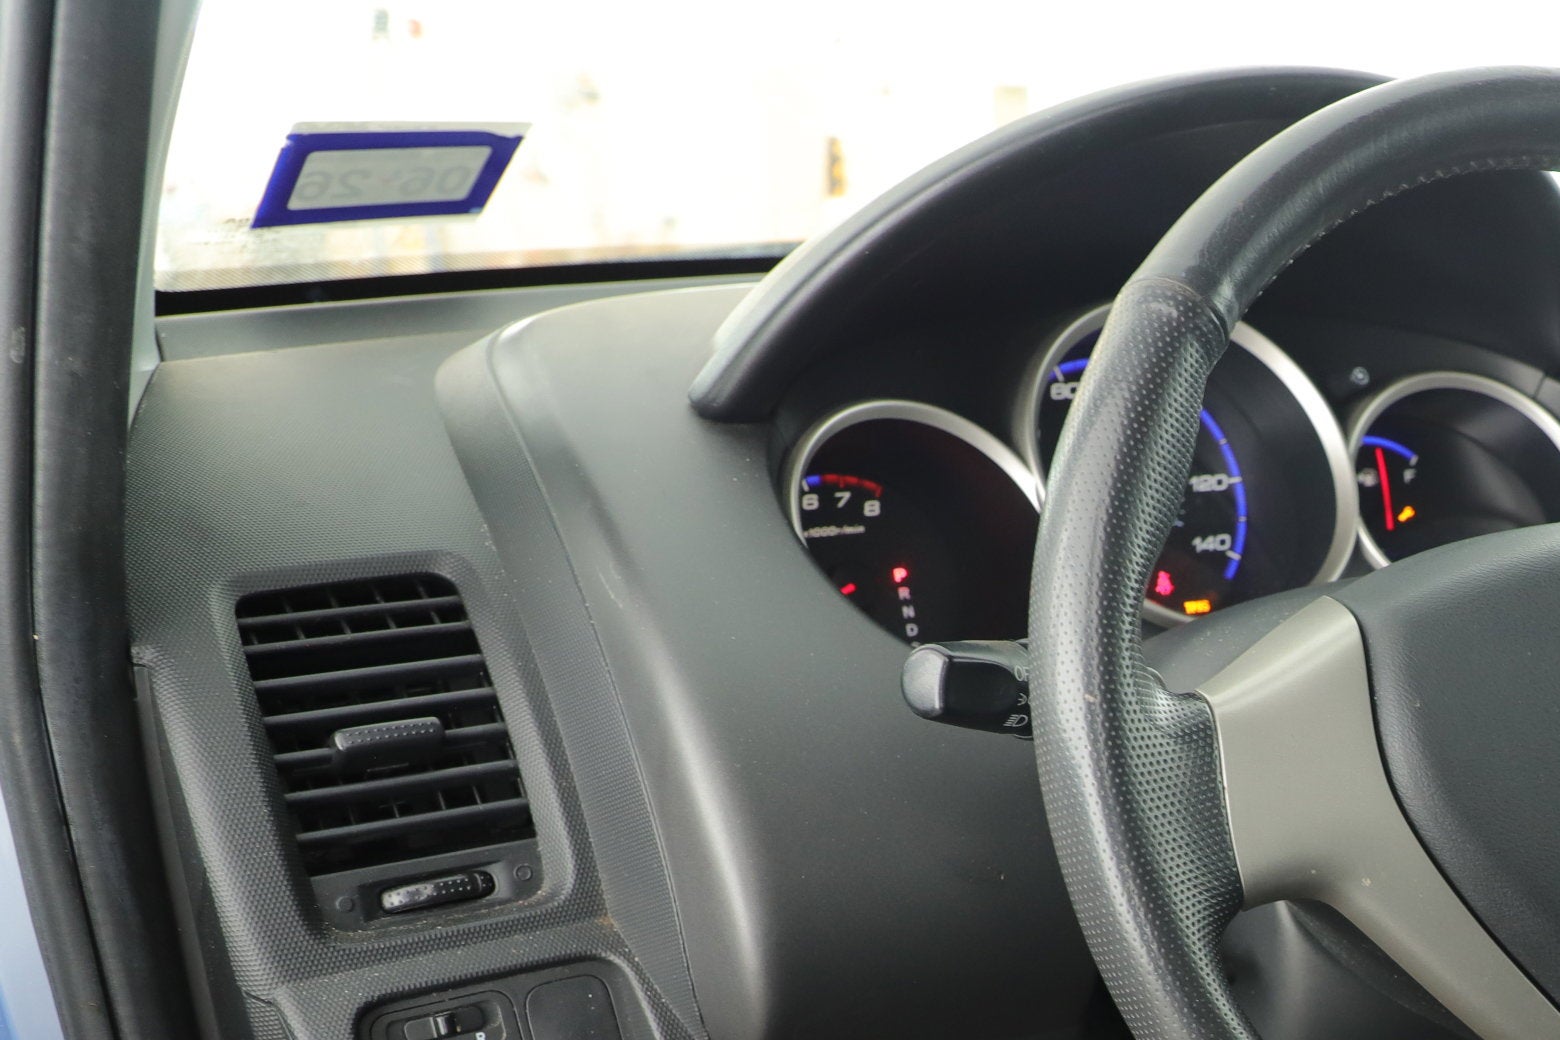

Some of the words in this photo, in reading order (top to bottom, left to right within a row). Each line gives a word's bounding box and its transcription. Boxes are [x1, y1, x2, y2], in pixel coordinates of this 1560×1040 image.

[1189, 473, 1229, 493] 120
[834, 491, 851, 508] 7
[1191, 533, 1231, 553] 140
[892, 566, 908, 583] P
[1014, 665, 1030, 682] OF
